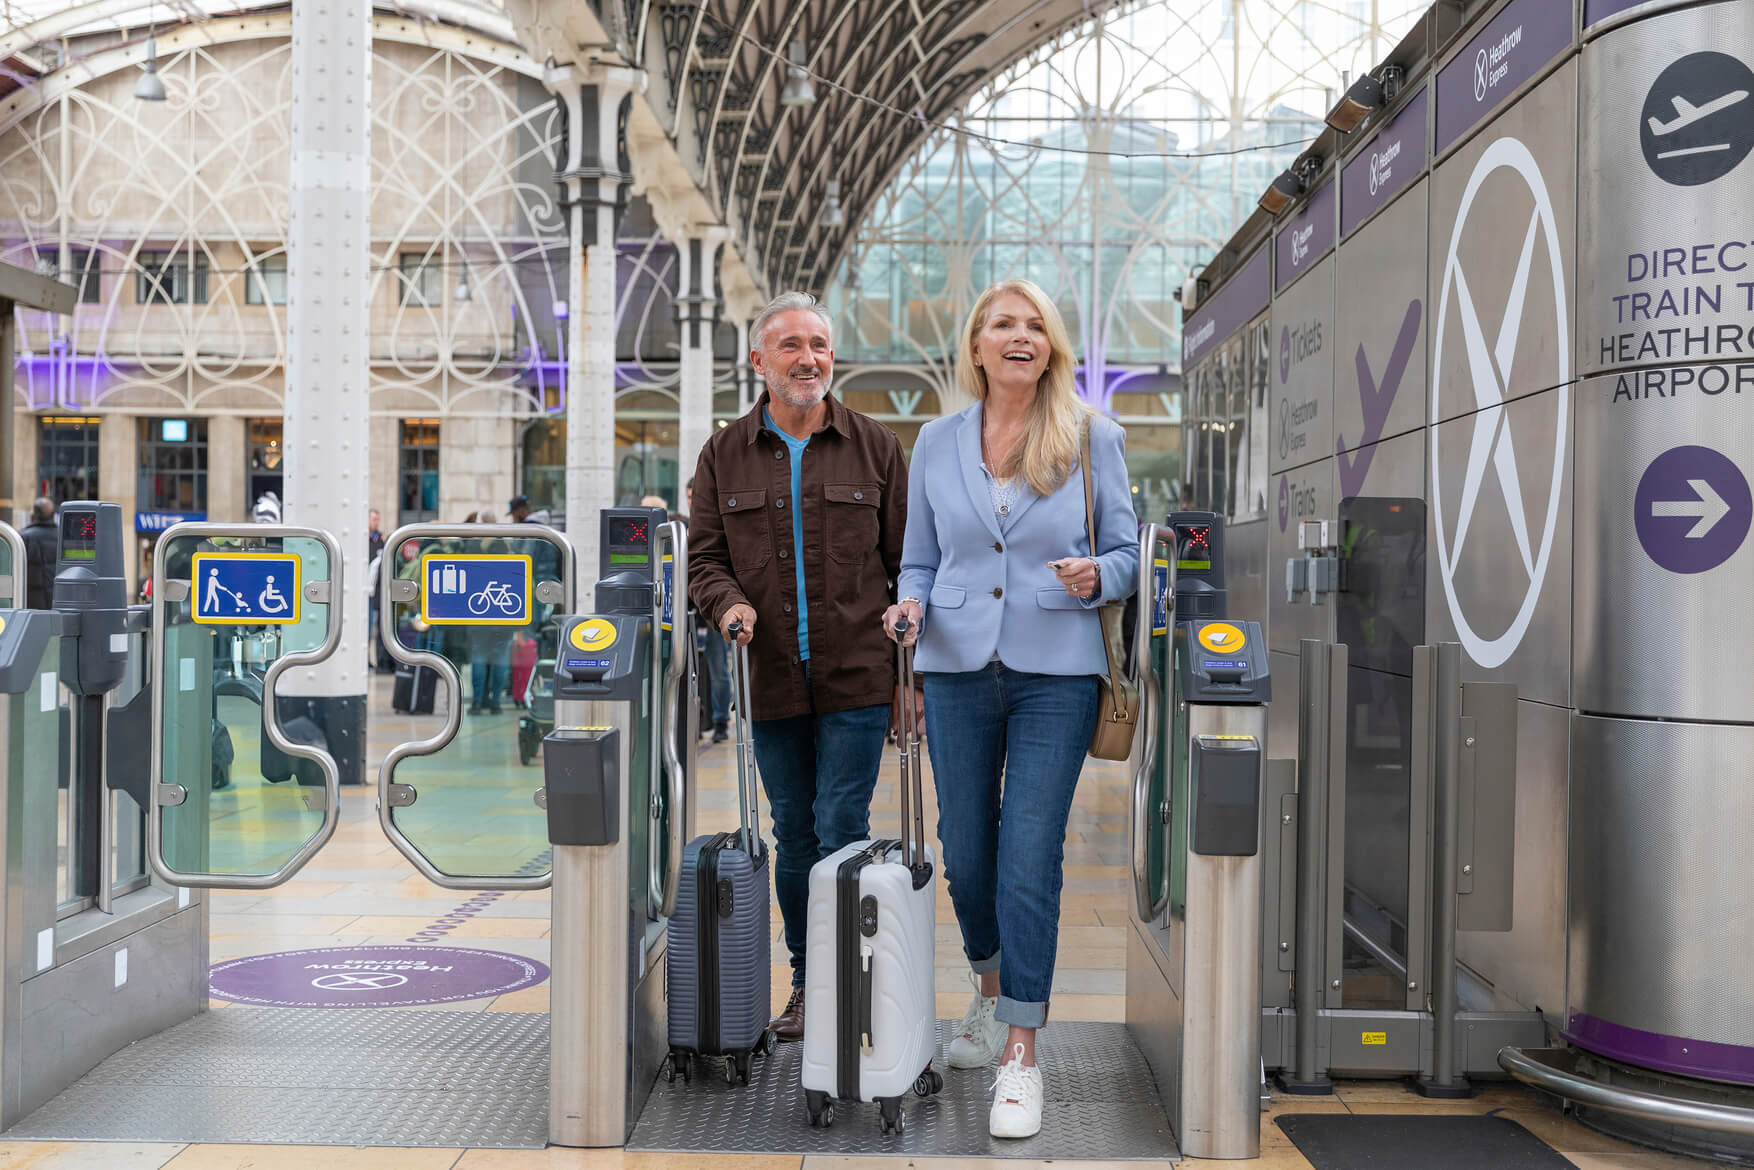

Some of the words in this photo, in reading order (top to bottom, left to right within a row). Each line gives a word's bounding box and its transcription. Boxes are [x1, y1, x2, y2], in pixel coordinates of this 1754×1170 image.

[1489, 25, 1522, 69] Heathrow
[1489, 61, 1508, 88] Express
[1379, 140, 1401, 169] Heathrow
[1628, 241, 1754, 282] DIREC
[1612, 284, 1722, 324] TRAIN
[1291, 319, 1322, 366] Tickets
[1600, 324, 1754, 365] HEATHR
[1290, 480, 1316, 518] Trains
[304, 963, 453, 972] Heathrow
[323, 997, 438, 1006] TRAVELLING
